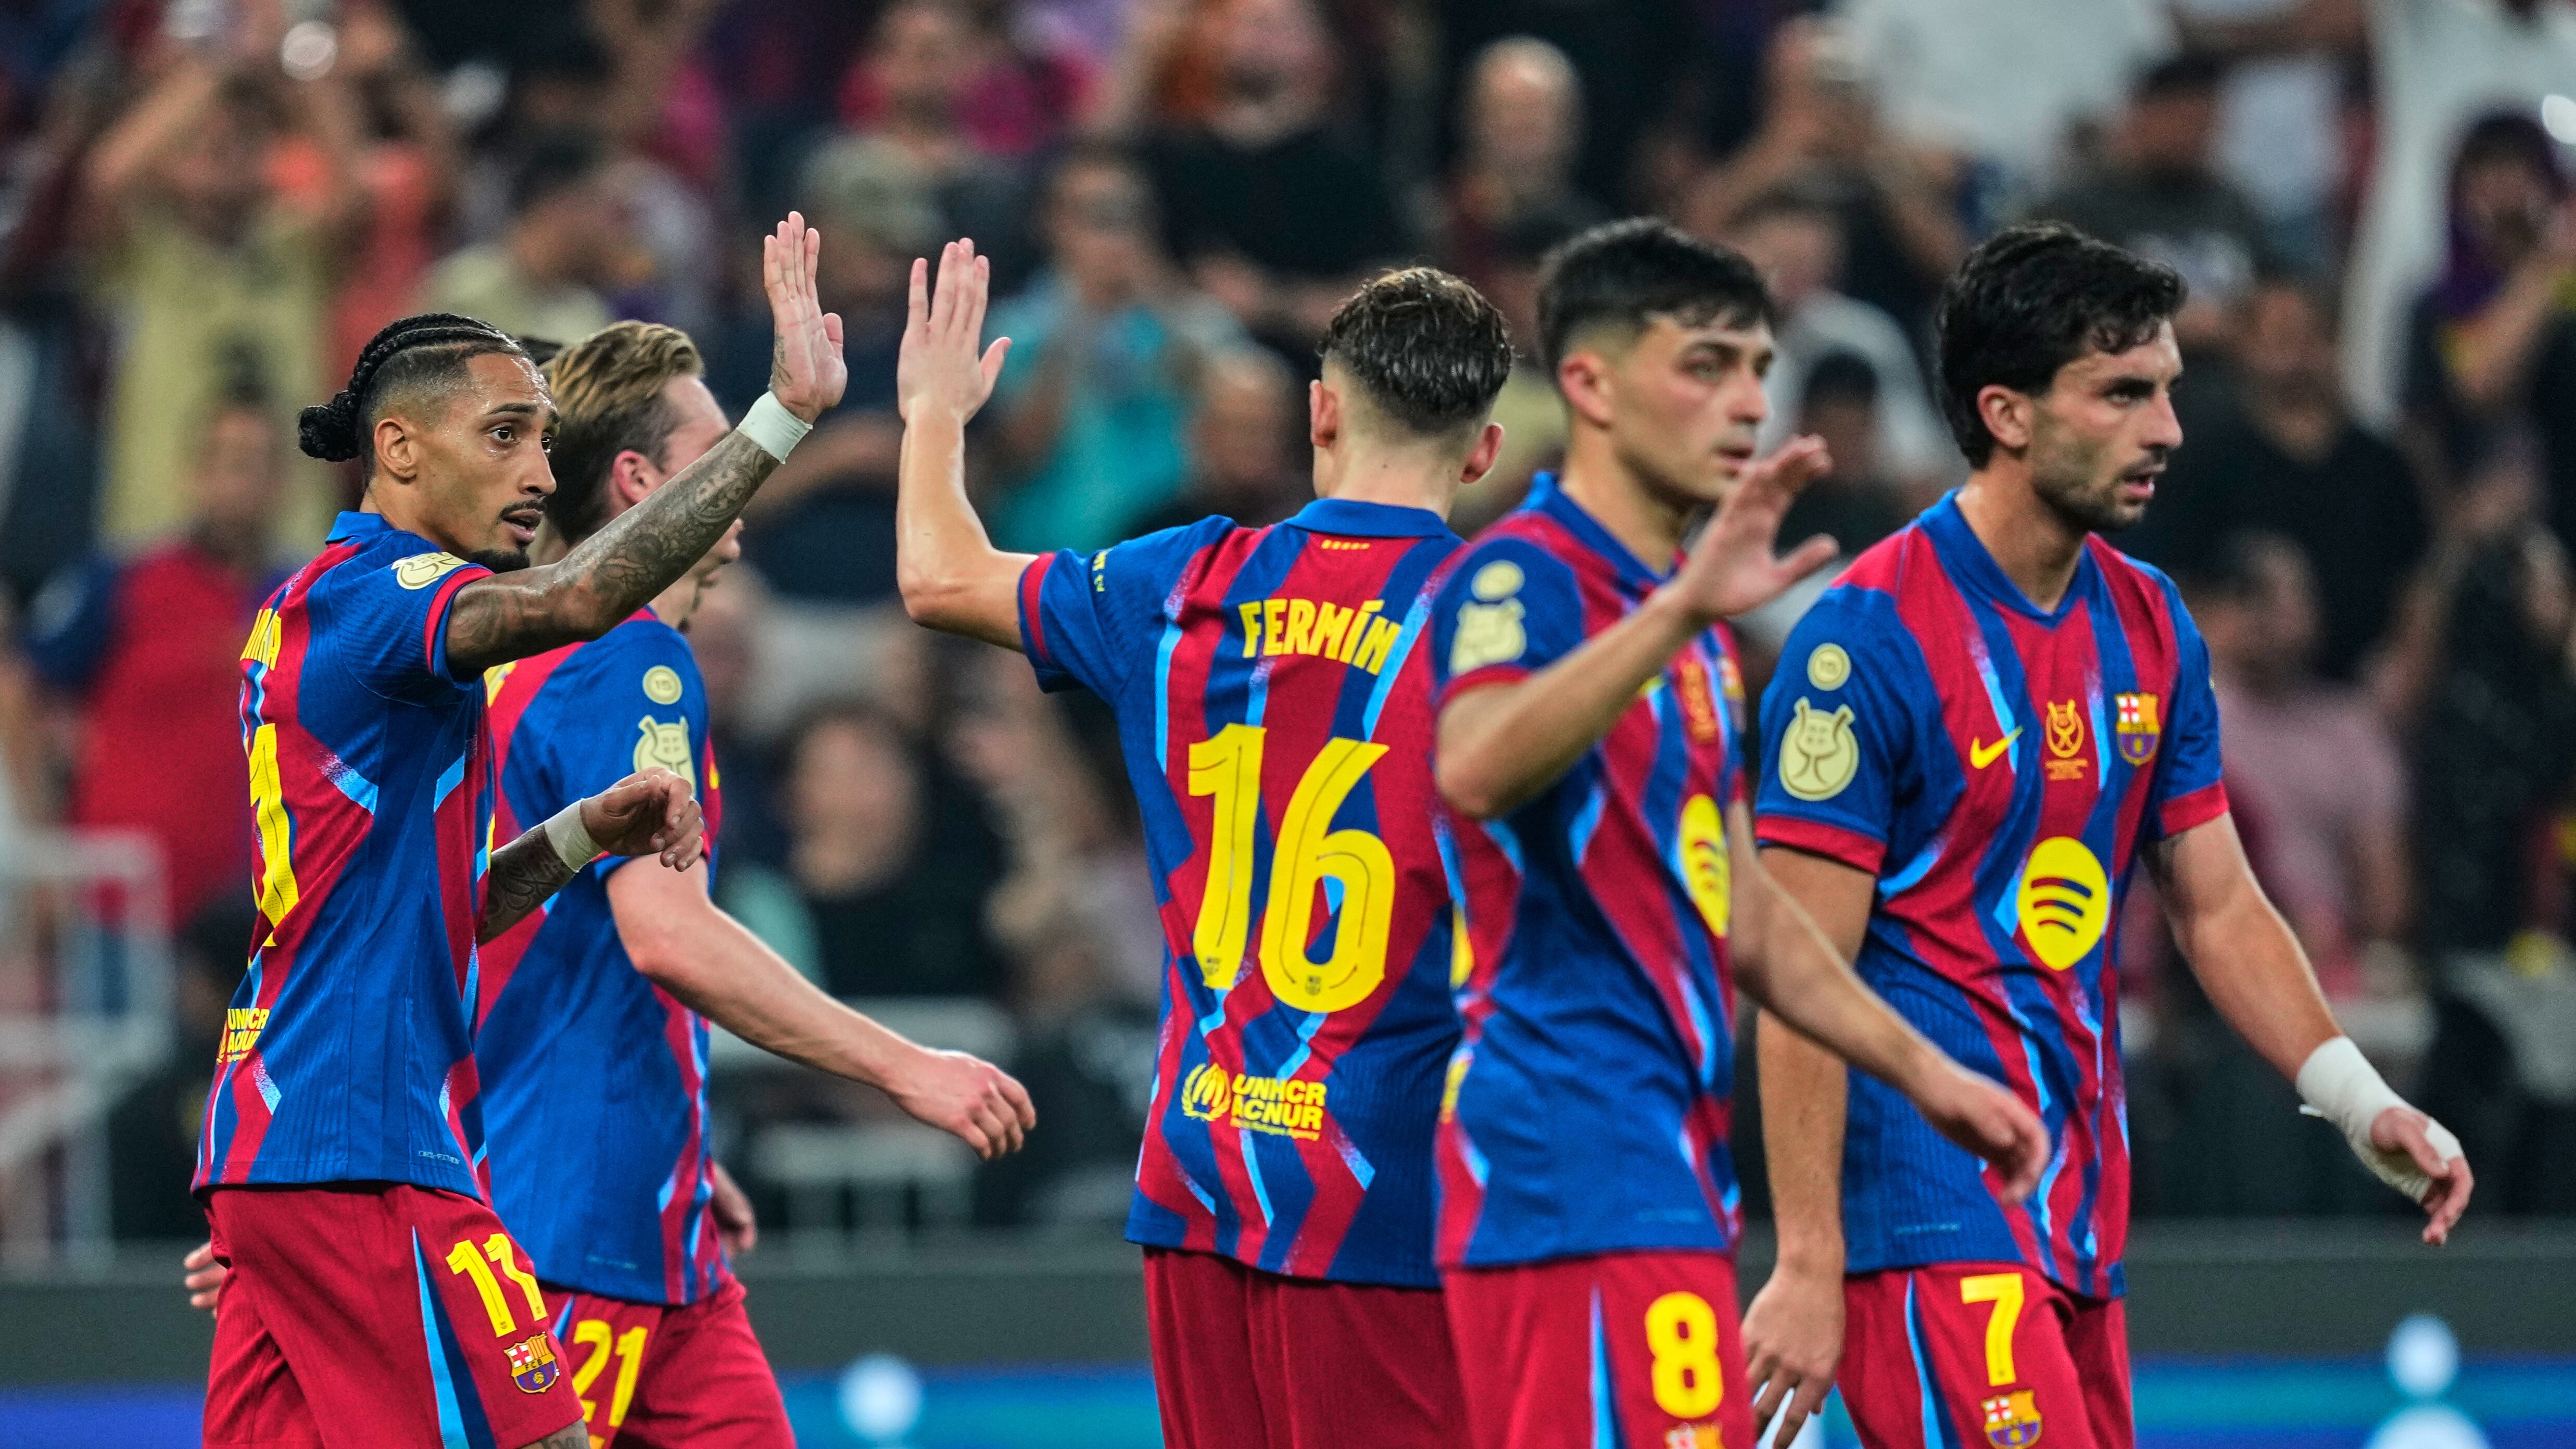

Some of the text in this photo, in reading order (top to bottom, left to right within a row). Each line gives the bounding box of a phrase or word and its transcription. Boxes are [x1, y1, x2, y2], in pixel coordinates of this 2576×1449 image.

[1238, 598, 1402, 676] FERMÍN
[1189, 723, 1395, 1013] 16
[1231, 1094, 1323, 1130] ACNUR
[1232, 1073, 1327, 1106] UNHCR
[446, 1233, 547, 1338] 11
[1961, 1272, 2025, 1387] 7
[525, 1358, 542, 1371] FCB
[573, 1319, 648, 1427] 21
[1645, 1291, 1724, 1419] 8
